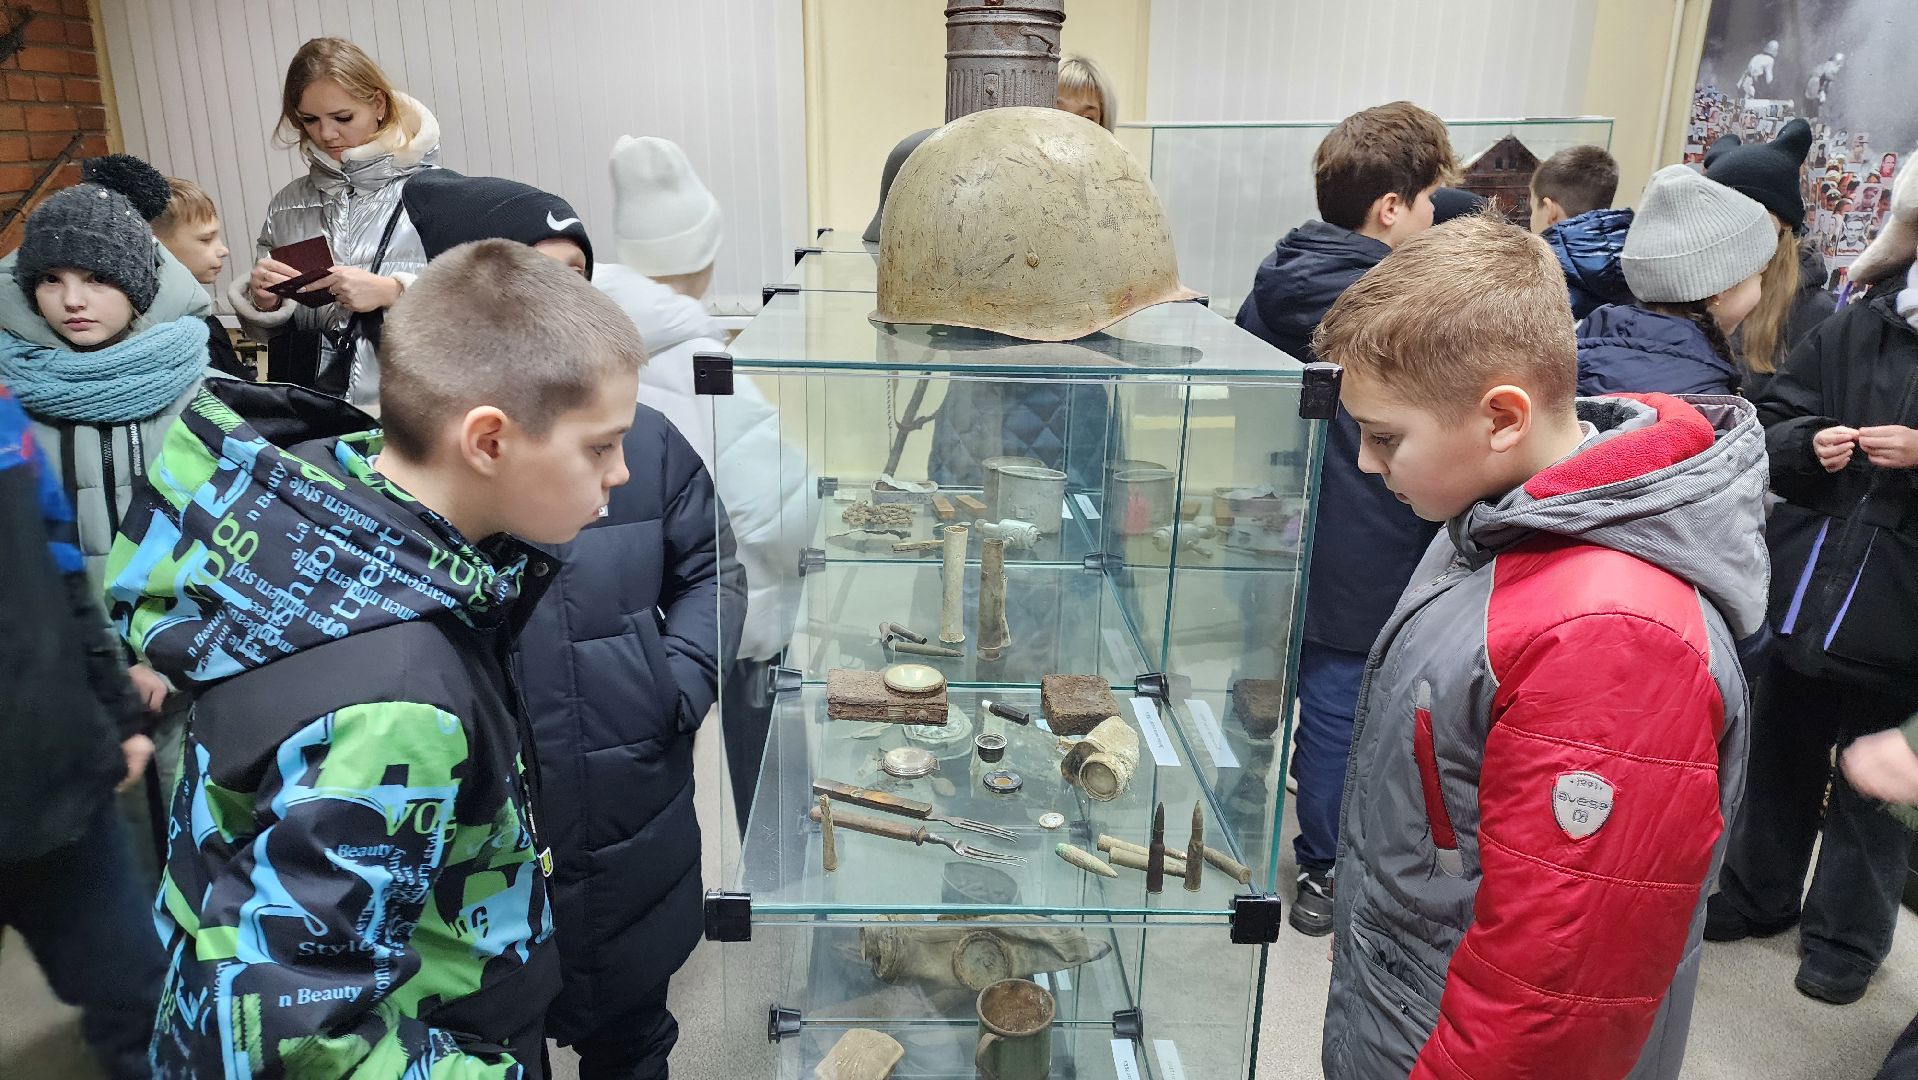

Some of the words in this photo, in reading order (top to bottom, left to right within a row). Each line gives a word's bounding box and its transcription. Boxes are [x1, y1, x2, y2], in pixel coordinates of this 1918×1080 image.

[289, 477, 325, 503] style
[321, 495, 379, 534] modern
[226, 561, 257, 584] styl
[297, 985, 362, 1005] Beauty
